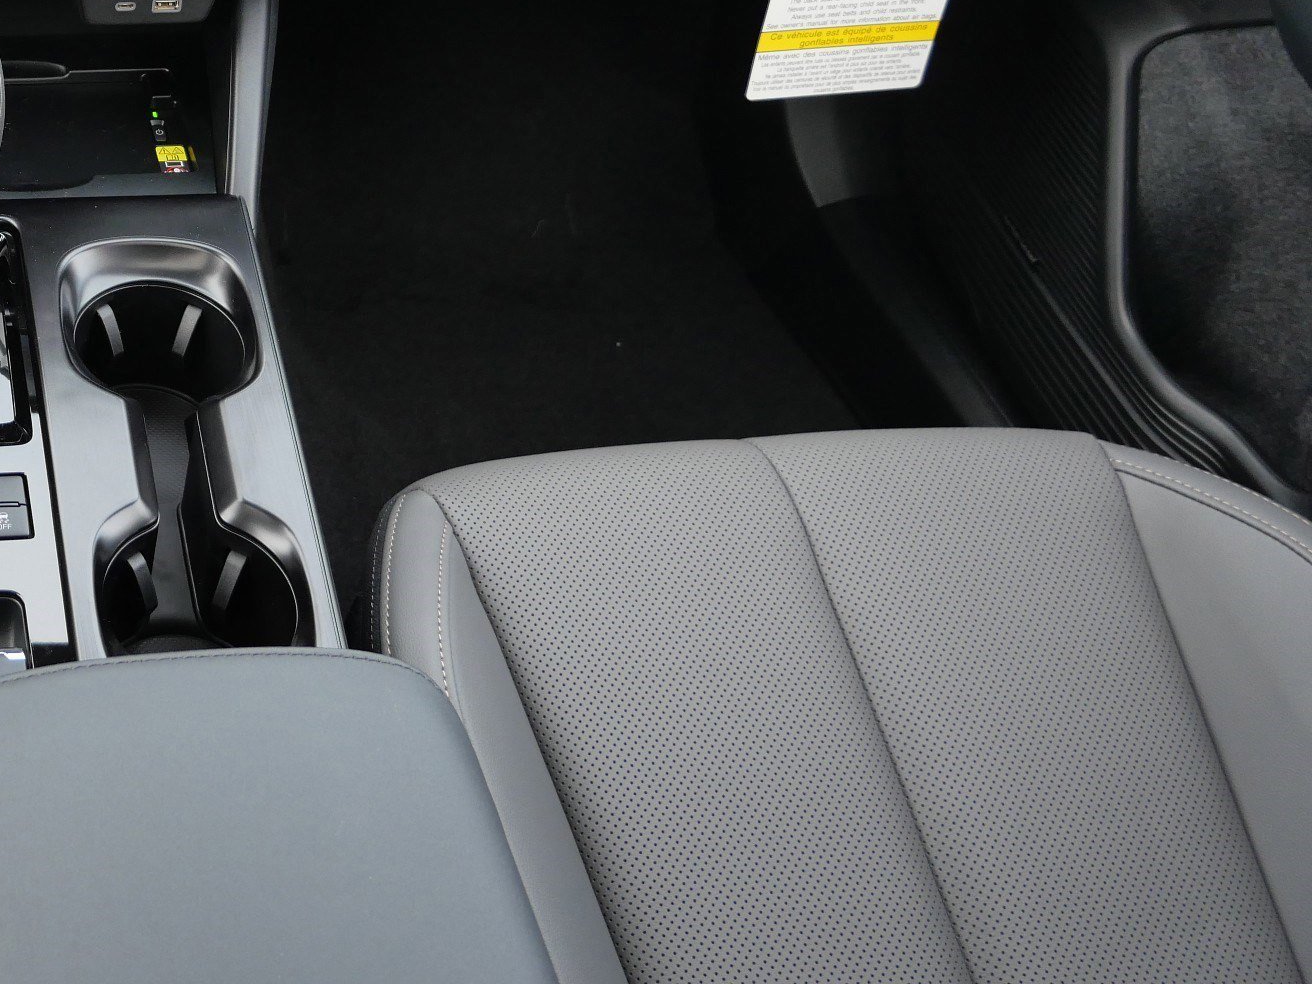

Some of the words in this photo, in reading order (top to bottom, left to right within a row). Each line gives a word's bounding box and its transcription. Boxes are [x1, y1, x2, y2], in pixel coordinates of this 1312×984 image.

[770, 33, 783, 41] Ce
[787, 30, 822, 39] véhicule
[826, 29, 839, 37] est
[843, 26, 872, 37] équipé
[875, 25, 887, 33] de
[890, 24, 928, 33] coussins
[799, 37, 843, 48] gonflables
[847, 34, 893, 44] intelligents
[758, 51, 781, 61] Même
[783, 52, 800, 60] avec
[803, 50, 816, 58] des
[819, 47, 850, 56] coussins
[852, 45, 888, 55] gonflables
